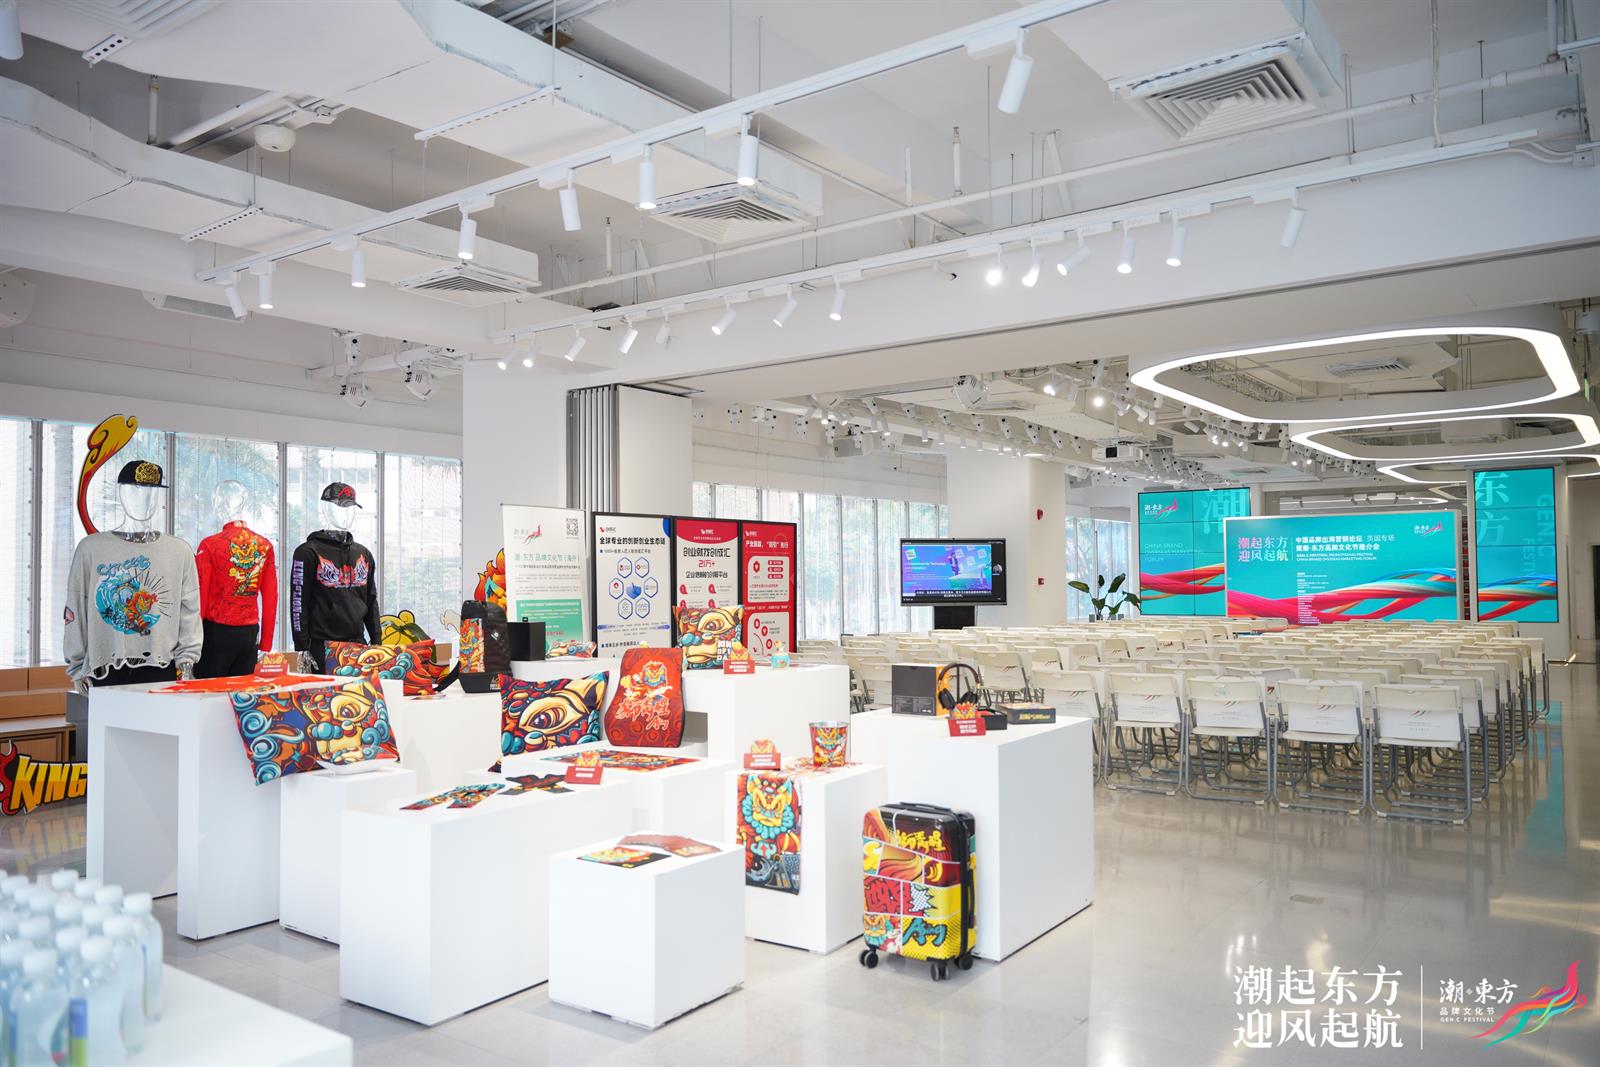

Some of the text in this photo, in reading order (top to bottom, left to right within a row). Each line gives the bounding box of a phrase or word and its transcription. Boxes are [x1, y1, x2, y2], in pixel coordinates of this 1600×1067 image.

[1238, 536, 1289, 549] 潮起东方
[1238, 549, 1289, 562] 迎风起航
[10, 755, 88, 813] KING
